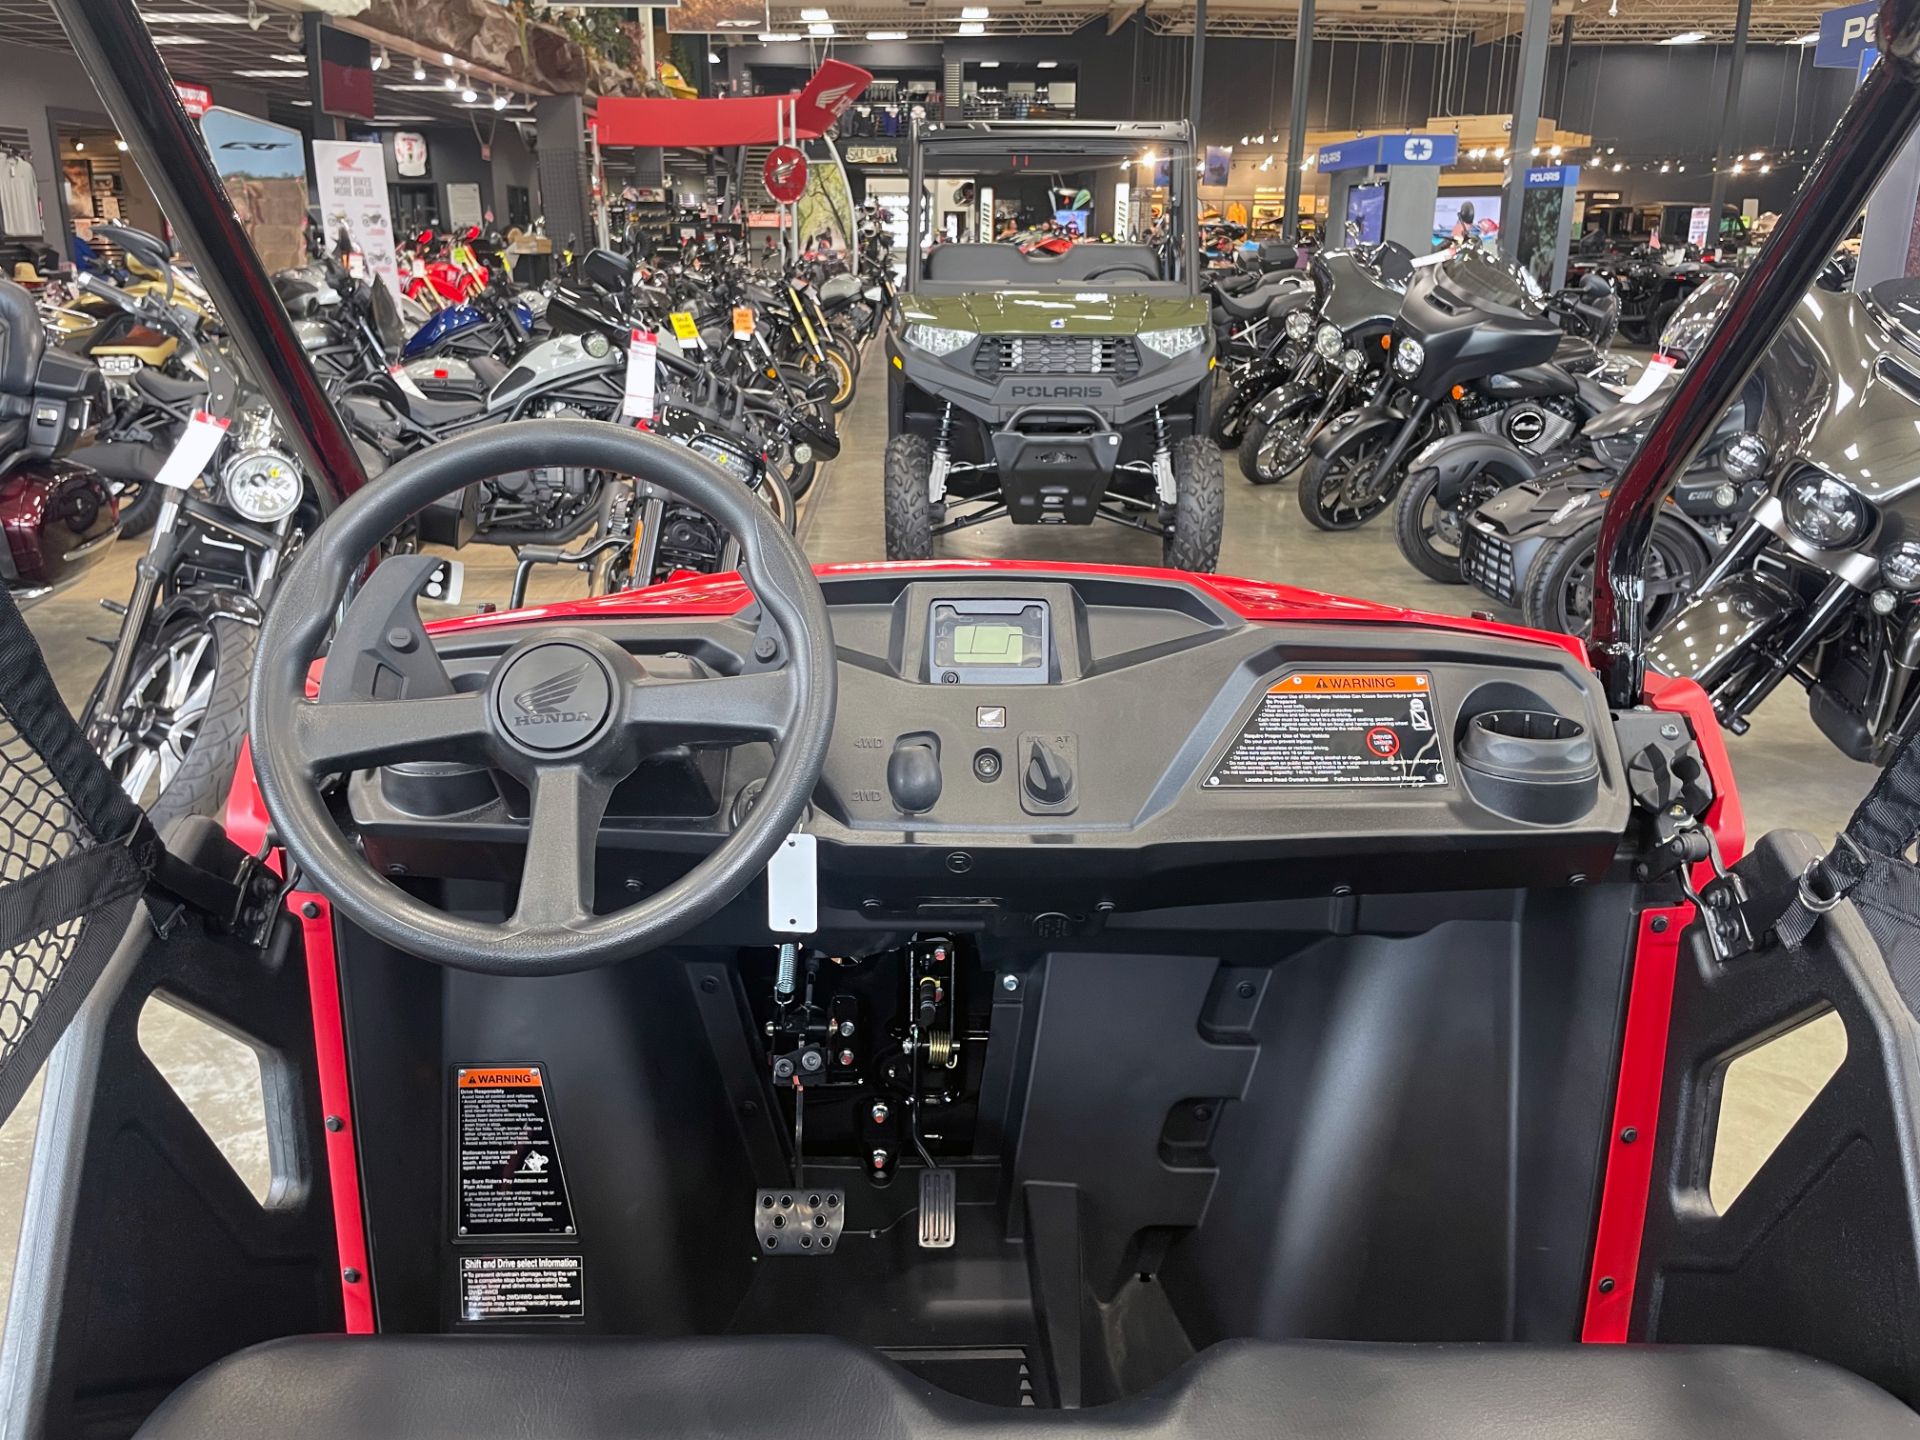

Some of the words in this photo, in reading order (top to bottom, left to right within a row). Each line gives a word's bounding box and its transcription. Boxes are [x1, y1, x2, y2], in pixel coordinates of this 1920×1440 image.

[220, 141, 292, 150] CRF
[1530, 171, 1560, 182] POLARIS
[1012, 386, 1102, 398] POLARIS
[1330, 678, 1395, 688] WARNING
[514, 712, 592, 726] HONDA
[854, 737, 884, 749] 4WD
[850, 791, 882, 802] 2WD
[478, 1074, 531, 1084] WARNING
[465, 1260, 481, 1269] Shift
[483, 1260, 496, 1268] and
[497, 1259, 515, 1268] Drive
[517, 1259, 537, 1268] select
[539, 1259, 578, 1268] Information
